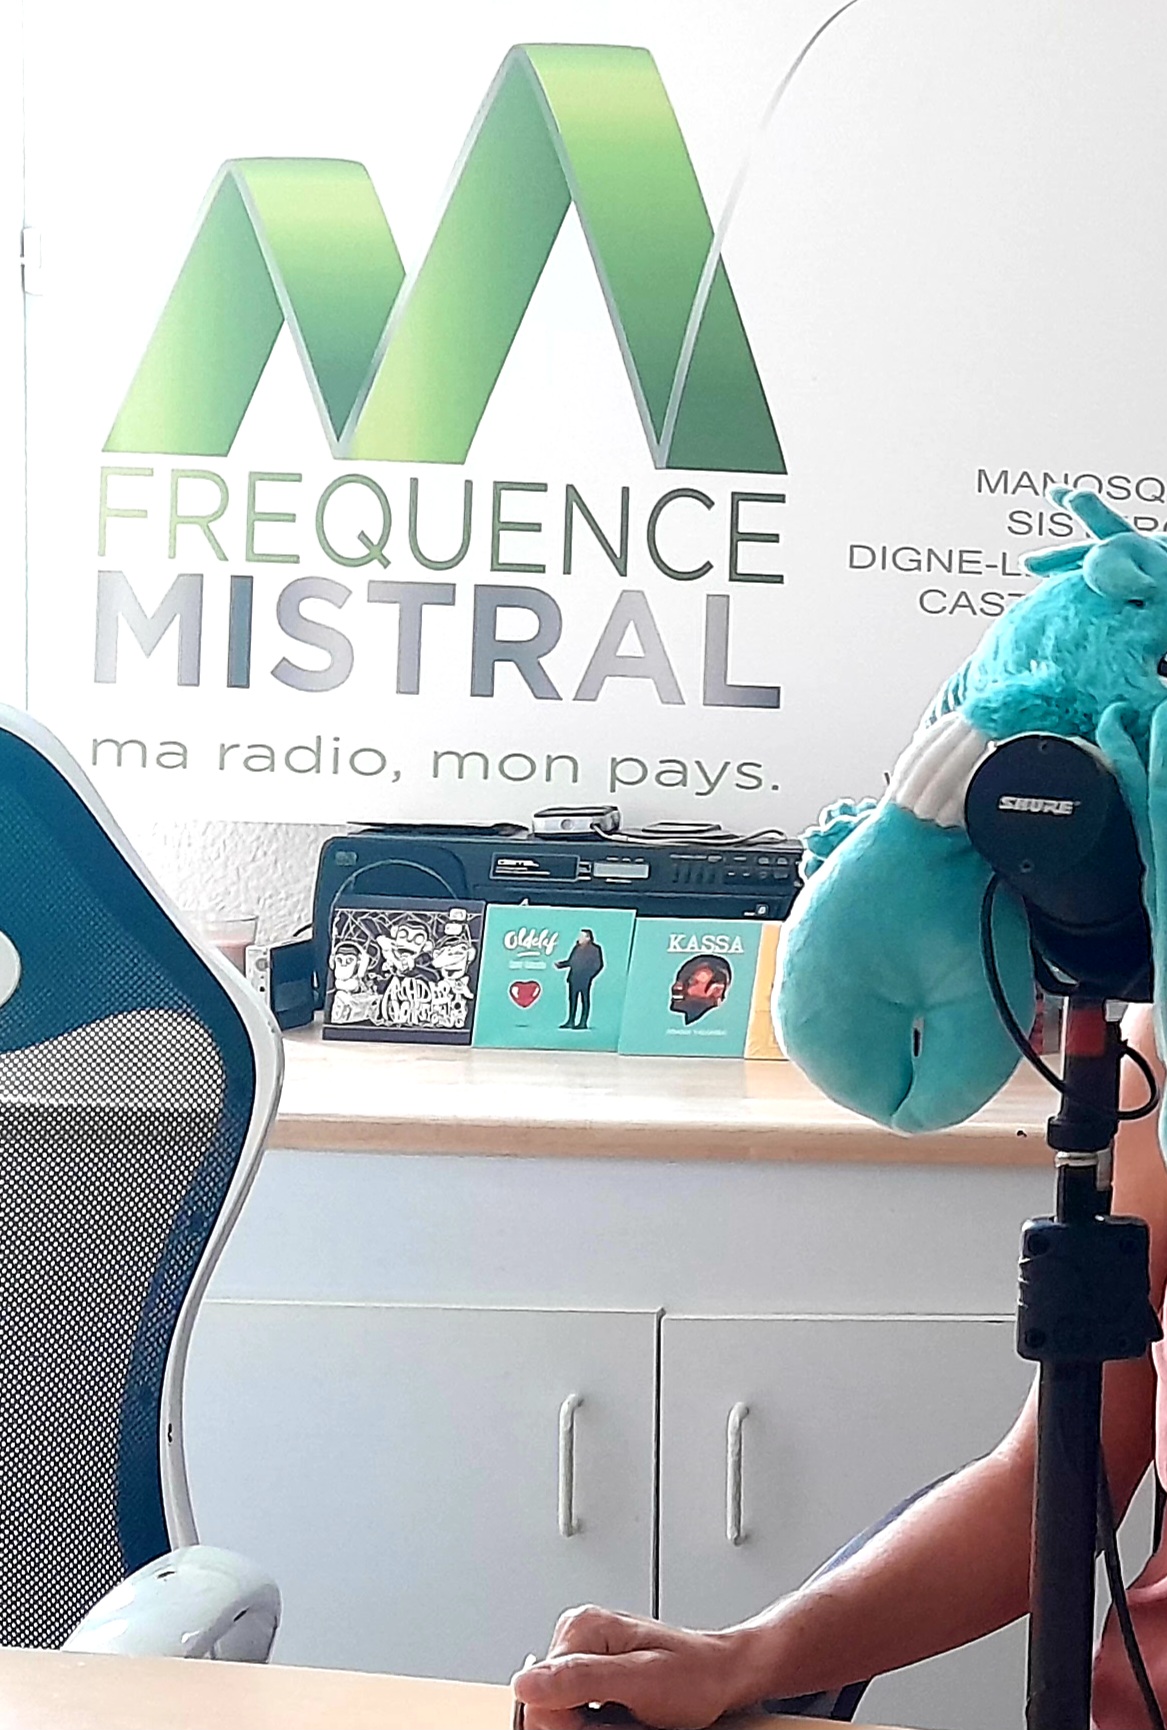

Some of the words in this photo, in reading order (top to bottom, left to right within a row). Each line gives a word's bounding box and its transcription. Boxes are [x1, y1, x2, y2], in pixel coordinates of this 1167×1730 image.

[98, 466, 787, 585] FREQUENCE
[94, 570, 782, 709] MISTRAL
[91, 737, 188, 770] ma
[218, 735, 402, 783] radio,
[432, 750, 579, 784] mon
[610, 753, 782, 796] pays.
[999, 796, 1074, 815] SHURE
[667, 934, 744, 954] KASSA
